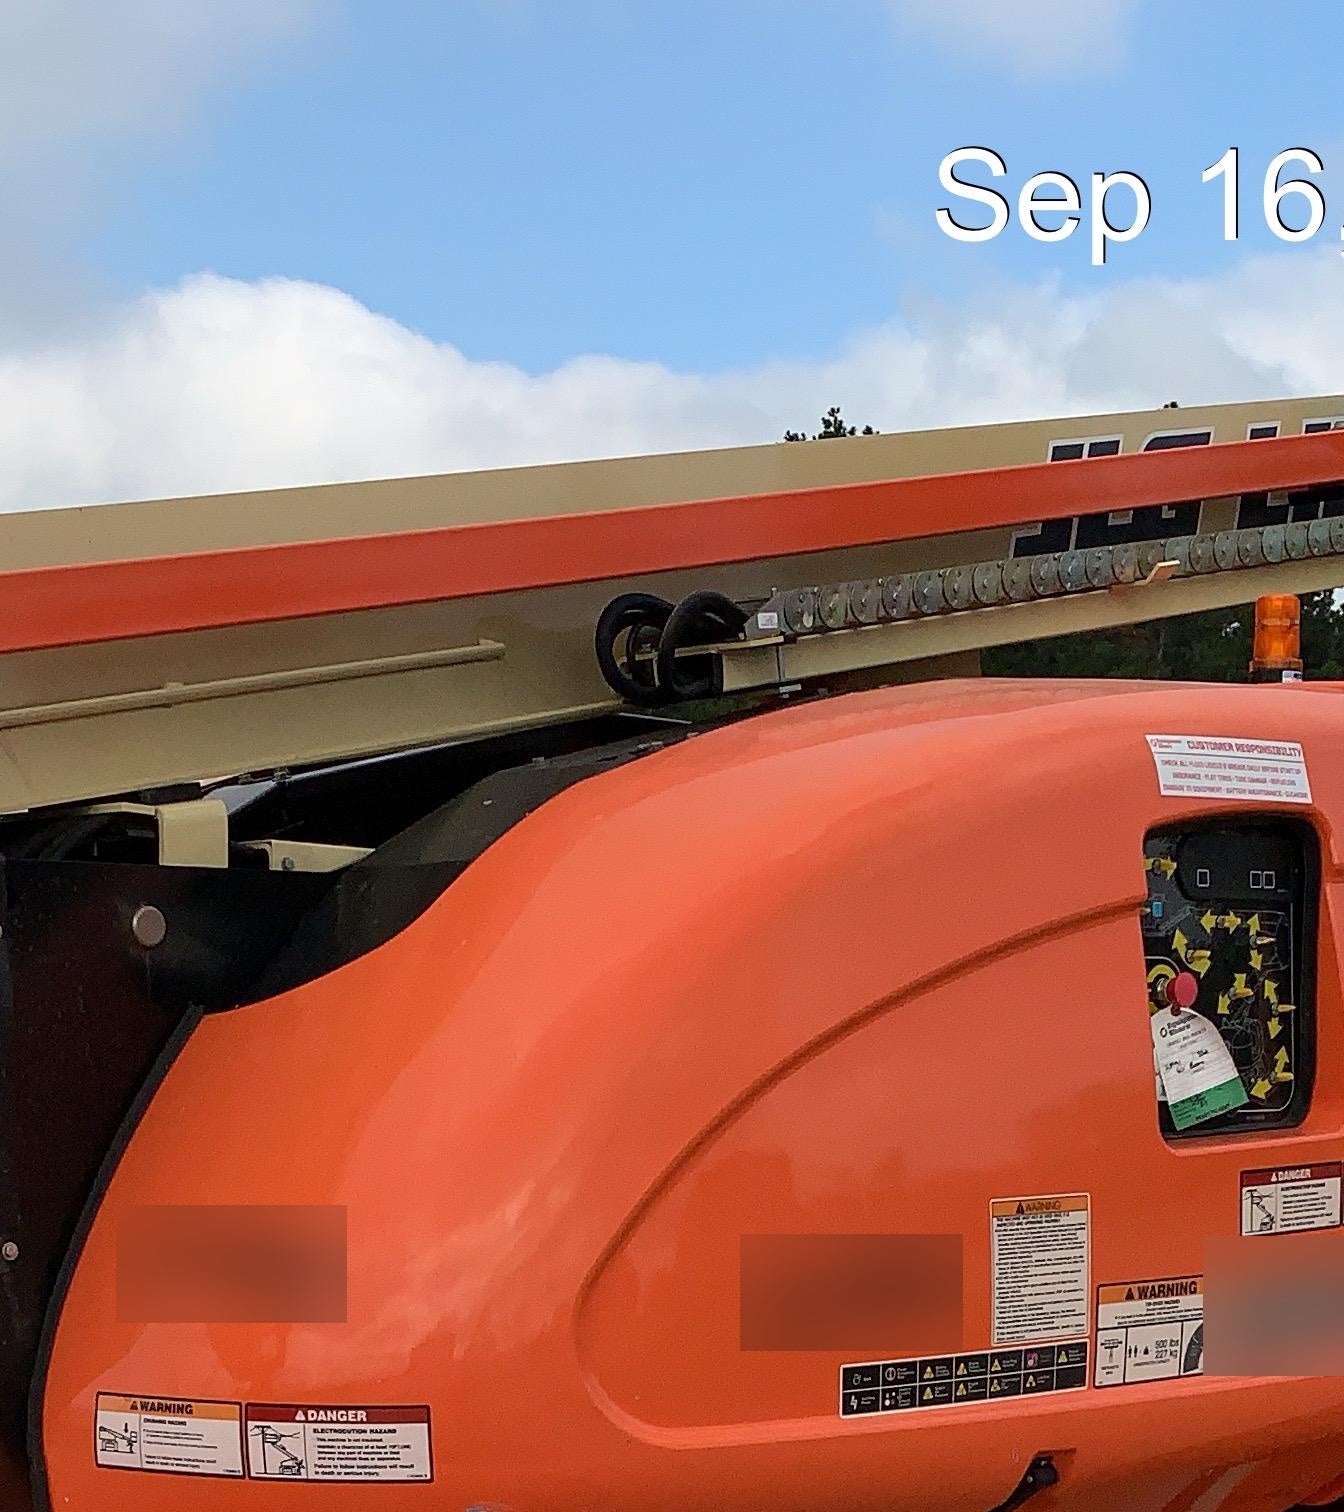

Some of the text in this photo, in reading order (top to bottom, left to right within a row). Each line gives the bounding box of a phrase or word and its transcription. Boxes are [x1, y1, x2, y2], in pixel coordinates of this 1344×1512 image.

[1278, 1168, 1312, 1181] DANGER
[1137, 1280, 1197, 1301] WARNING
[139, 1400, 194, 1416] WARNING
[307, 1410, 368, 1422] DANGER
